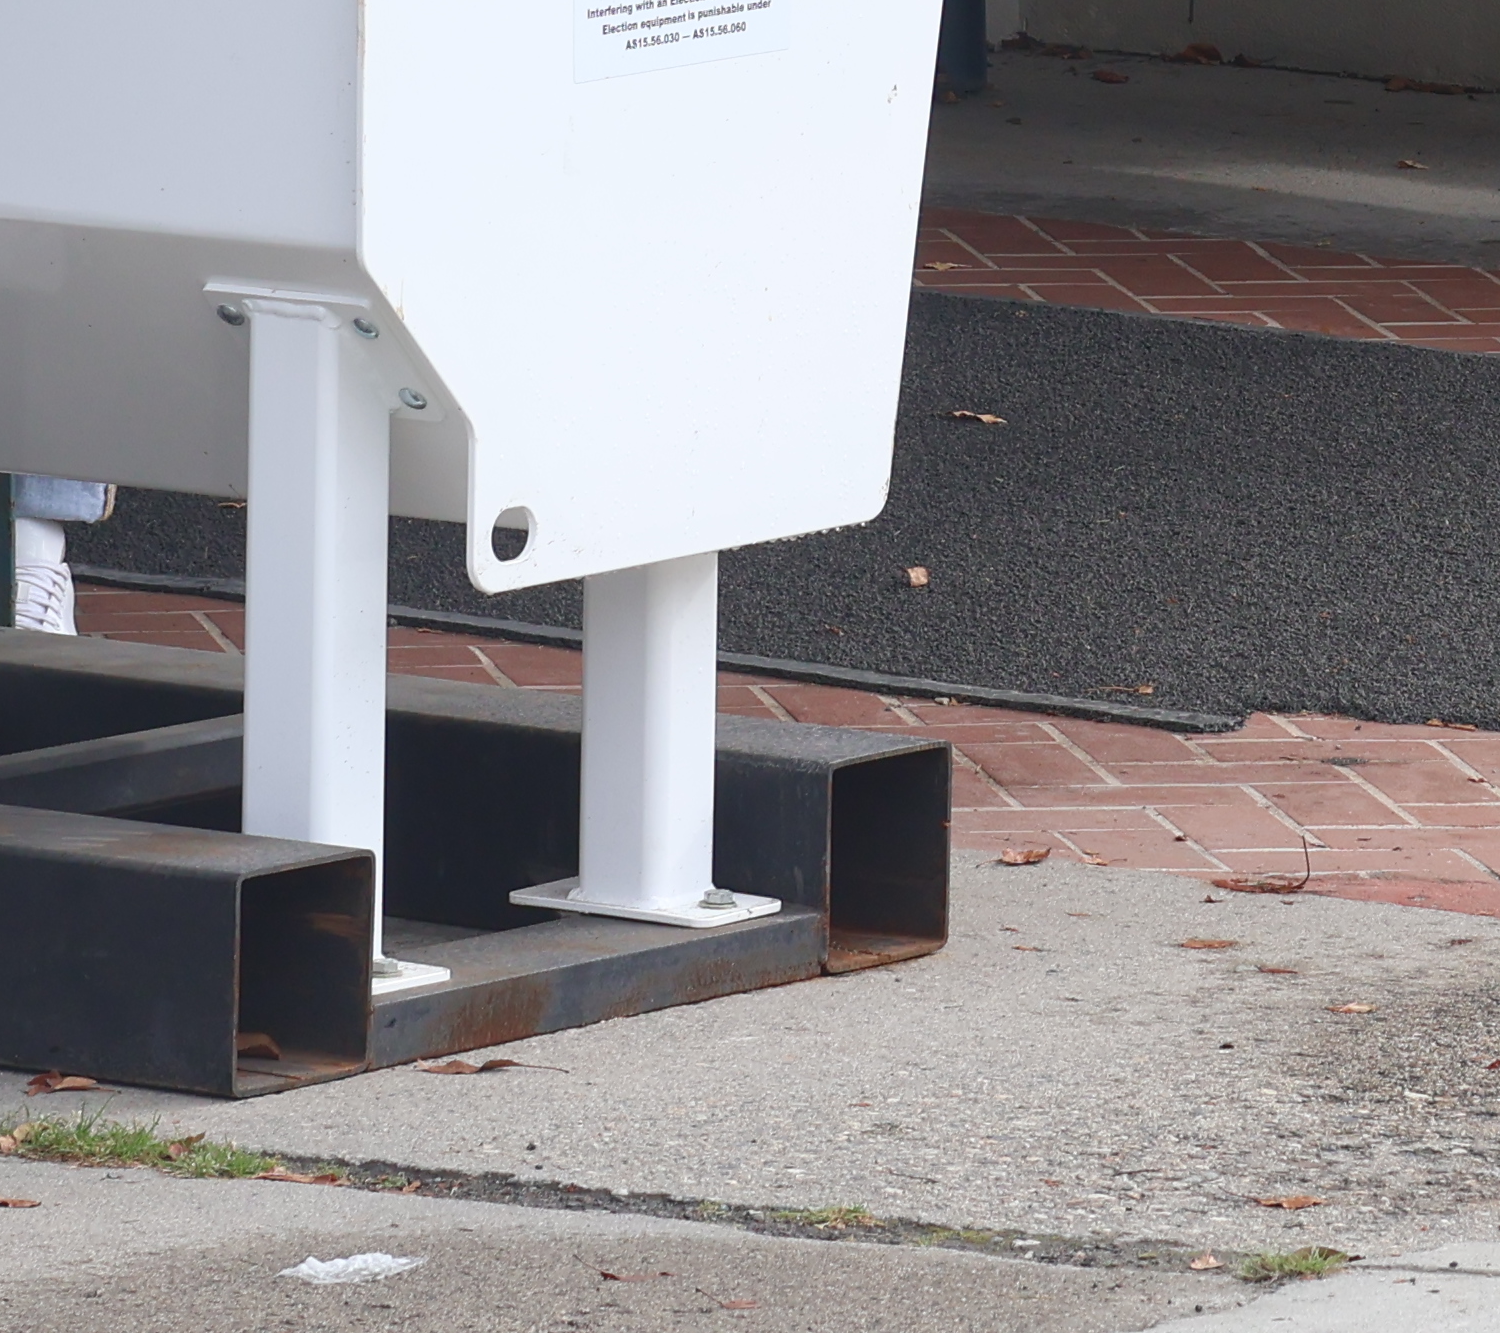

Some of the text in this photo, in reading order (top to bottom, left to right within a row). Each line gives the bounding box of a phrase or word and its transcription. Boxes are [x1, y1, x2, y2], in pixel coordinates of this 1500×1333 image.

[587, 3, 633, 19] Interfering
[636, 0, 654, 11] with
[602, 22, 637, 35] Election
[641, 13, 686, 30] equipment
[698, 3, 744, 21] punishable
[626, 22, 746, 50] AS15.56.030 AS15.56.060
